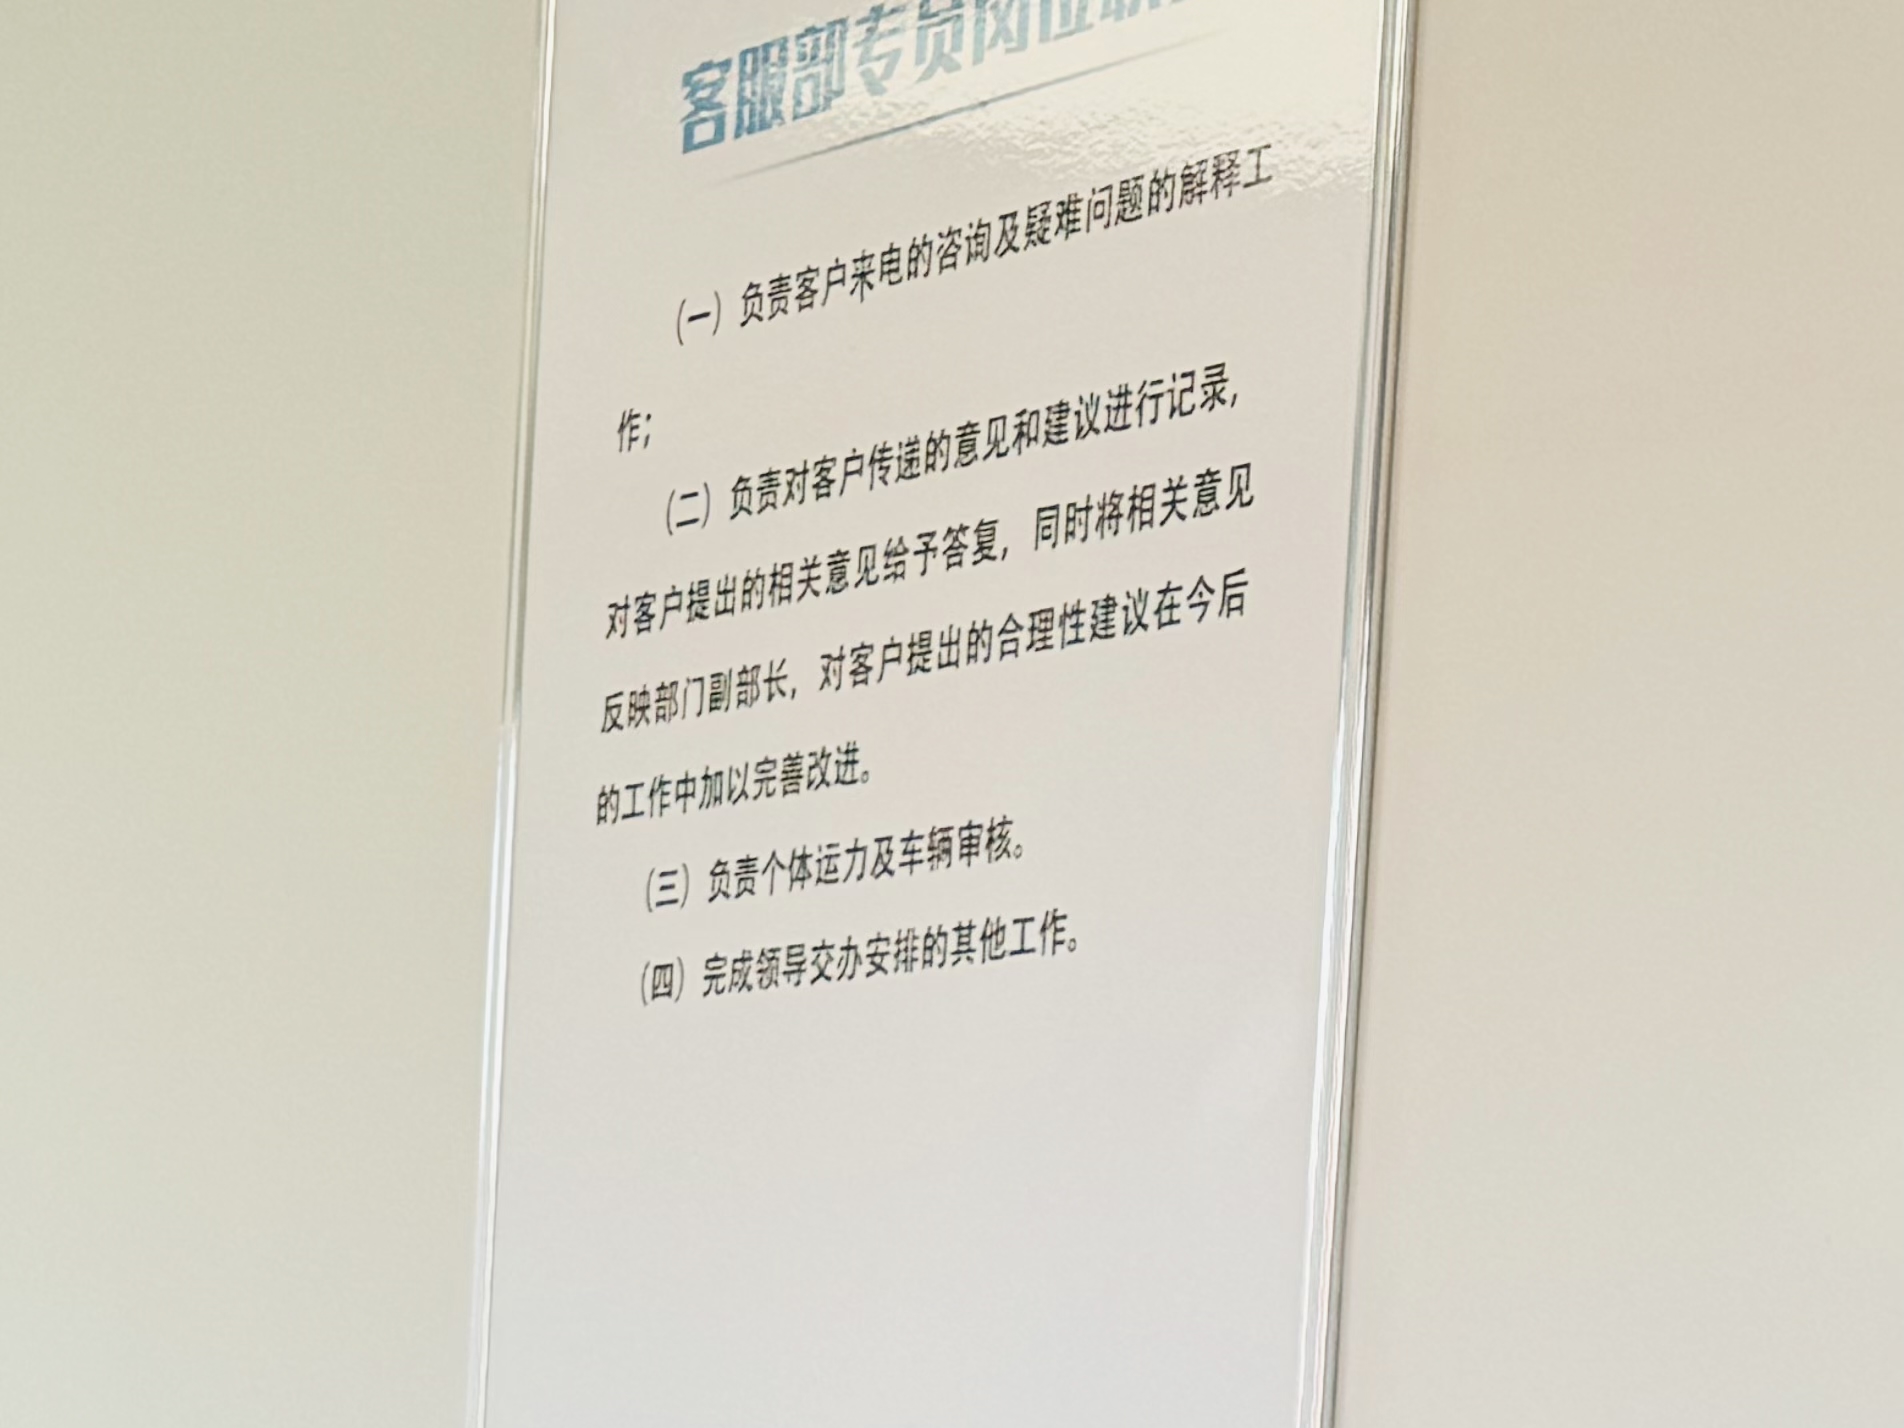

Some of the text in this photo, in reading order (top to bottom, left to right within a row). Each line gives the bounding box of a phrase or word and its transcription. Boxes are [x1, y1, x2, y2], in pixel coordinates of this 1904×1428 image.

[666, 362, 1239, 535] （二）负责对客户传递的意见和建议进行记录，
[606, 462, 1255, 640] 对客户提出的相关意见给予答复，同时将相关意见
[600, 567, 1249, 734] 反映部门副部长，对客户提出的合理性建议在今后
[595, 742, 872, 826] 的工作中加以完善改进。
[645, 815, 1025, 914] （三）负责个体运力及车辆审核。
[639, 906, 1079, 1008] （四）完成领导交办安排的其他工作。
